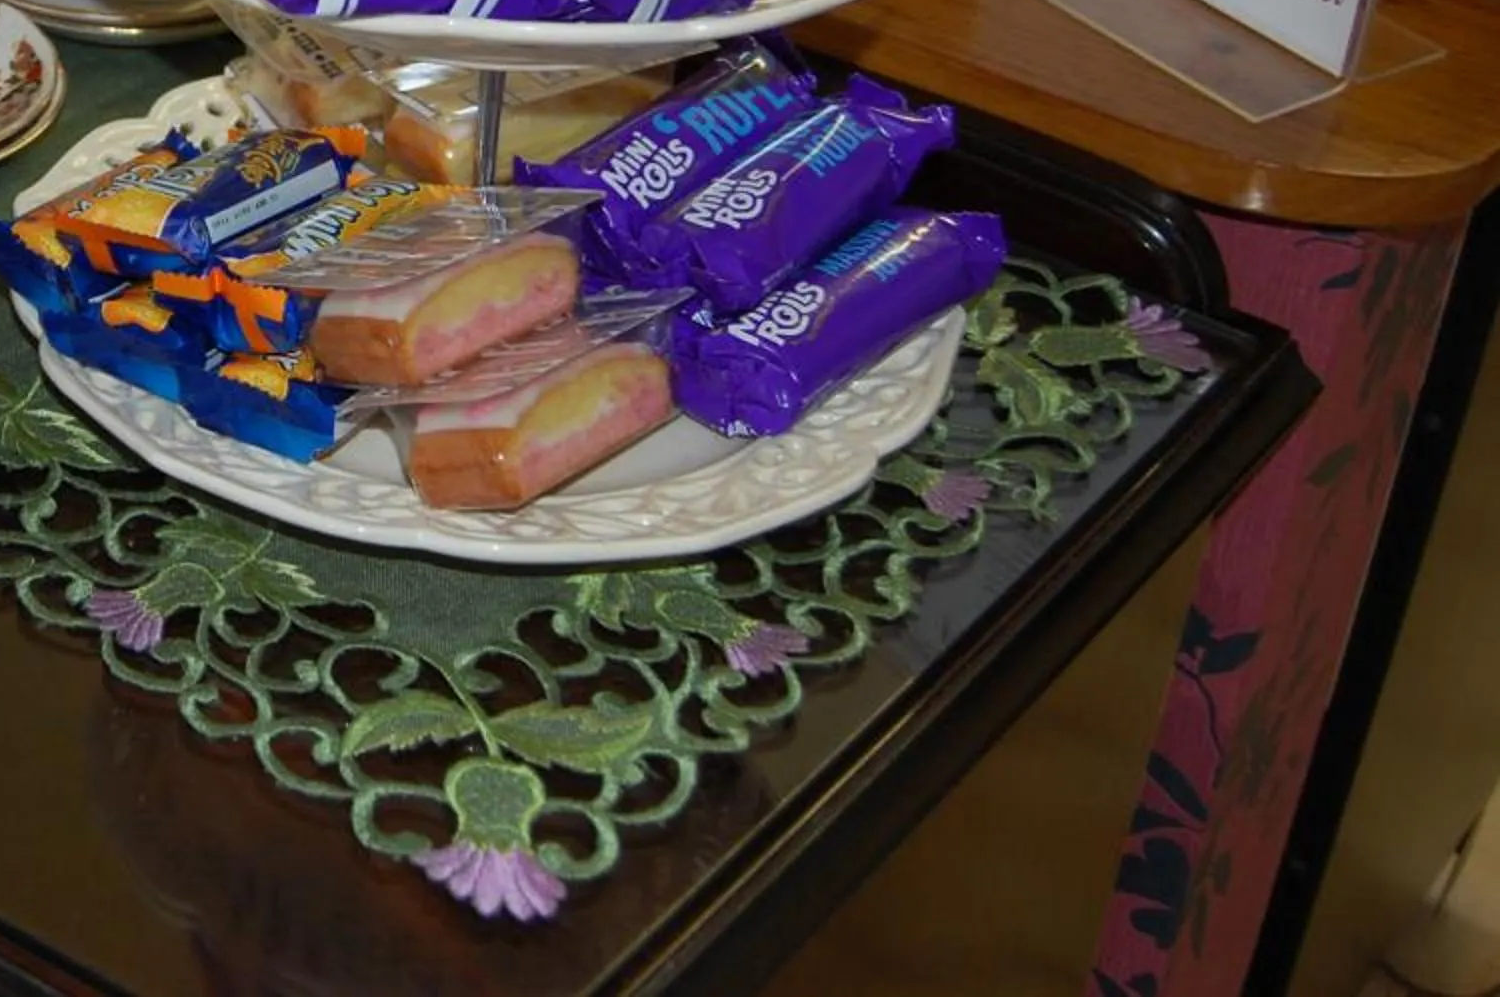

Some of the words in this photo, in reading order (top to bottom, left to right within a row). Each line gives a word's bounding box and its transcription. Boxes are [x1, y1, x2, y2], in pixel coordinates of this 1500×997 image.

[627, 138, 694, 209] ROLLS
[713, 168, 778, 230] ROLLS
[756, 281, 826, 347] ROLLS
